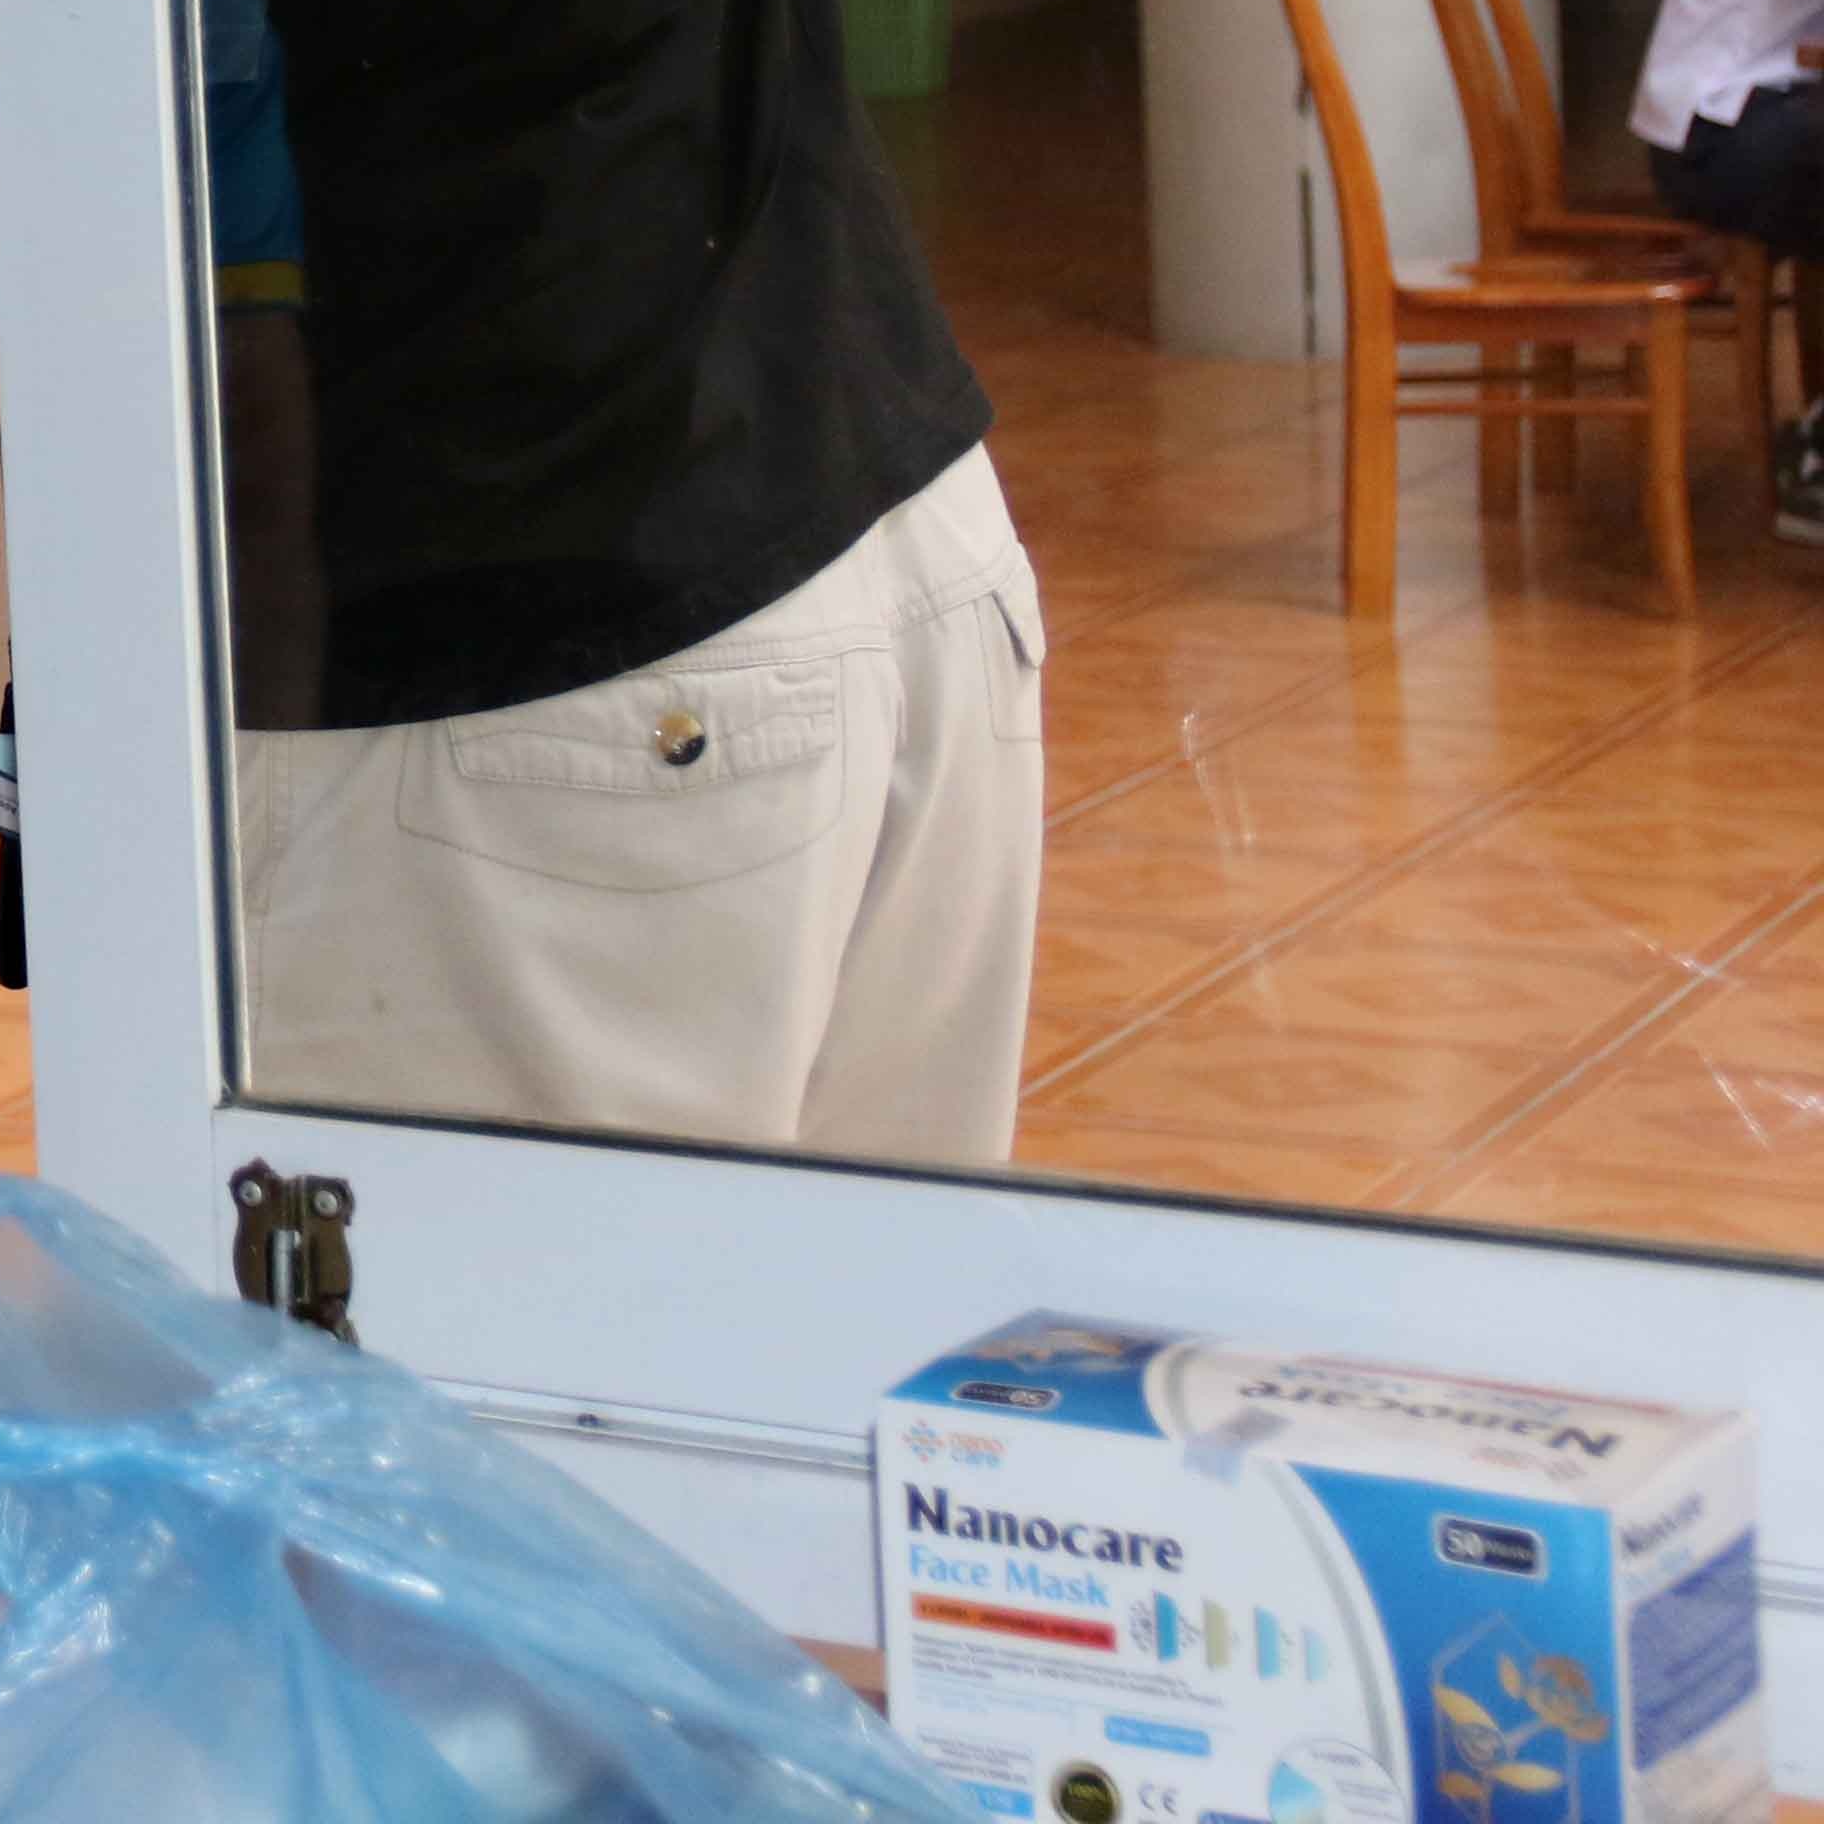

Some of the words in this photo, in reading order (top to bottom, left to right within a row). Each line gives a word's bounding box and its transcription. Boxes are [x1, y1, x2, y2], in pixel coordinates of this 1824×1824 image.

[903, 1480, 1185, 1574] Nanocare
[909, 1541, 991, 1587] Face
[1005, 1558, 1111, 1608] Mask
